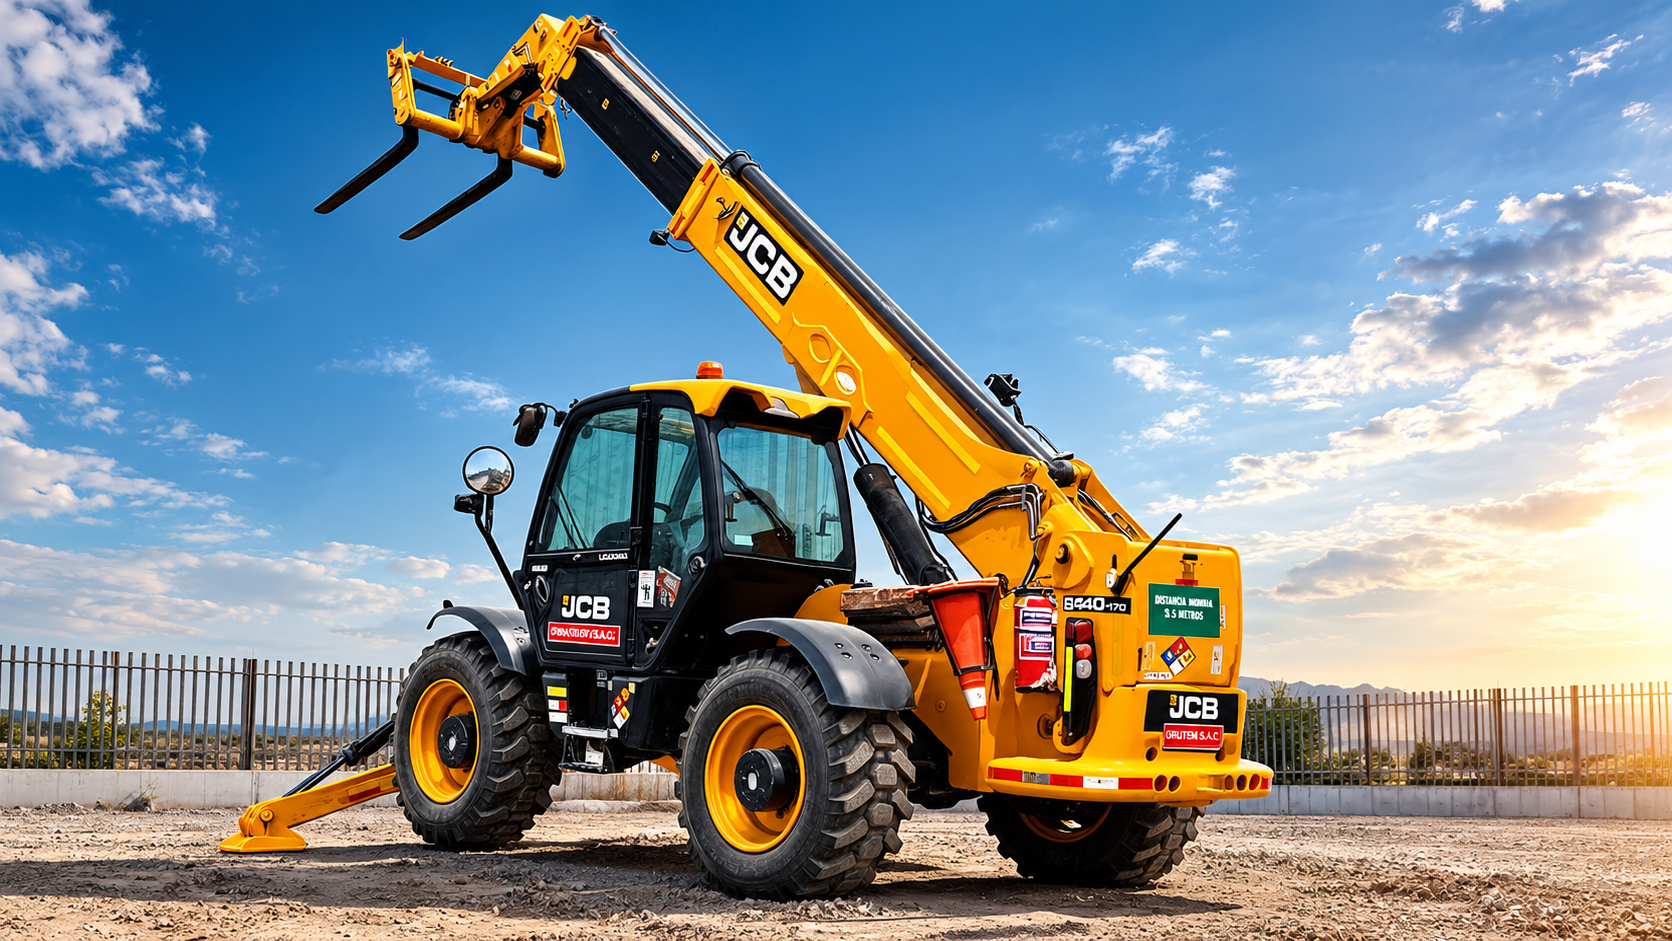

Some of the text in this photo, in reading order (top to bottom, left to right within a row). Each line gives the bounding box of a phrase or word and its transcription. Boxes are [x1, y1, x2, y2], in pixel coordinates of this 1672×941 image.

[729, 223, 798, 299] JCB
[561, 595, 610, 620] JCB
[1169, 695, 1219, 720] JCB
